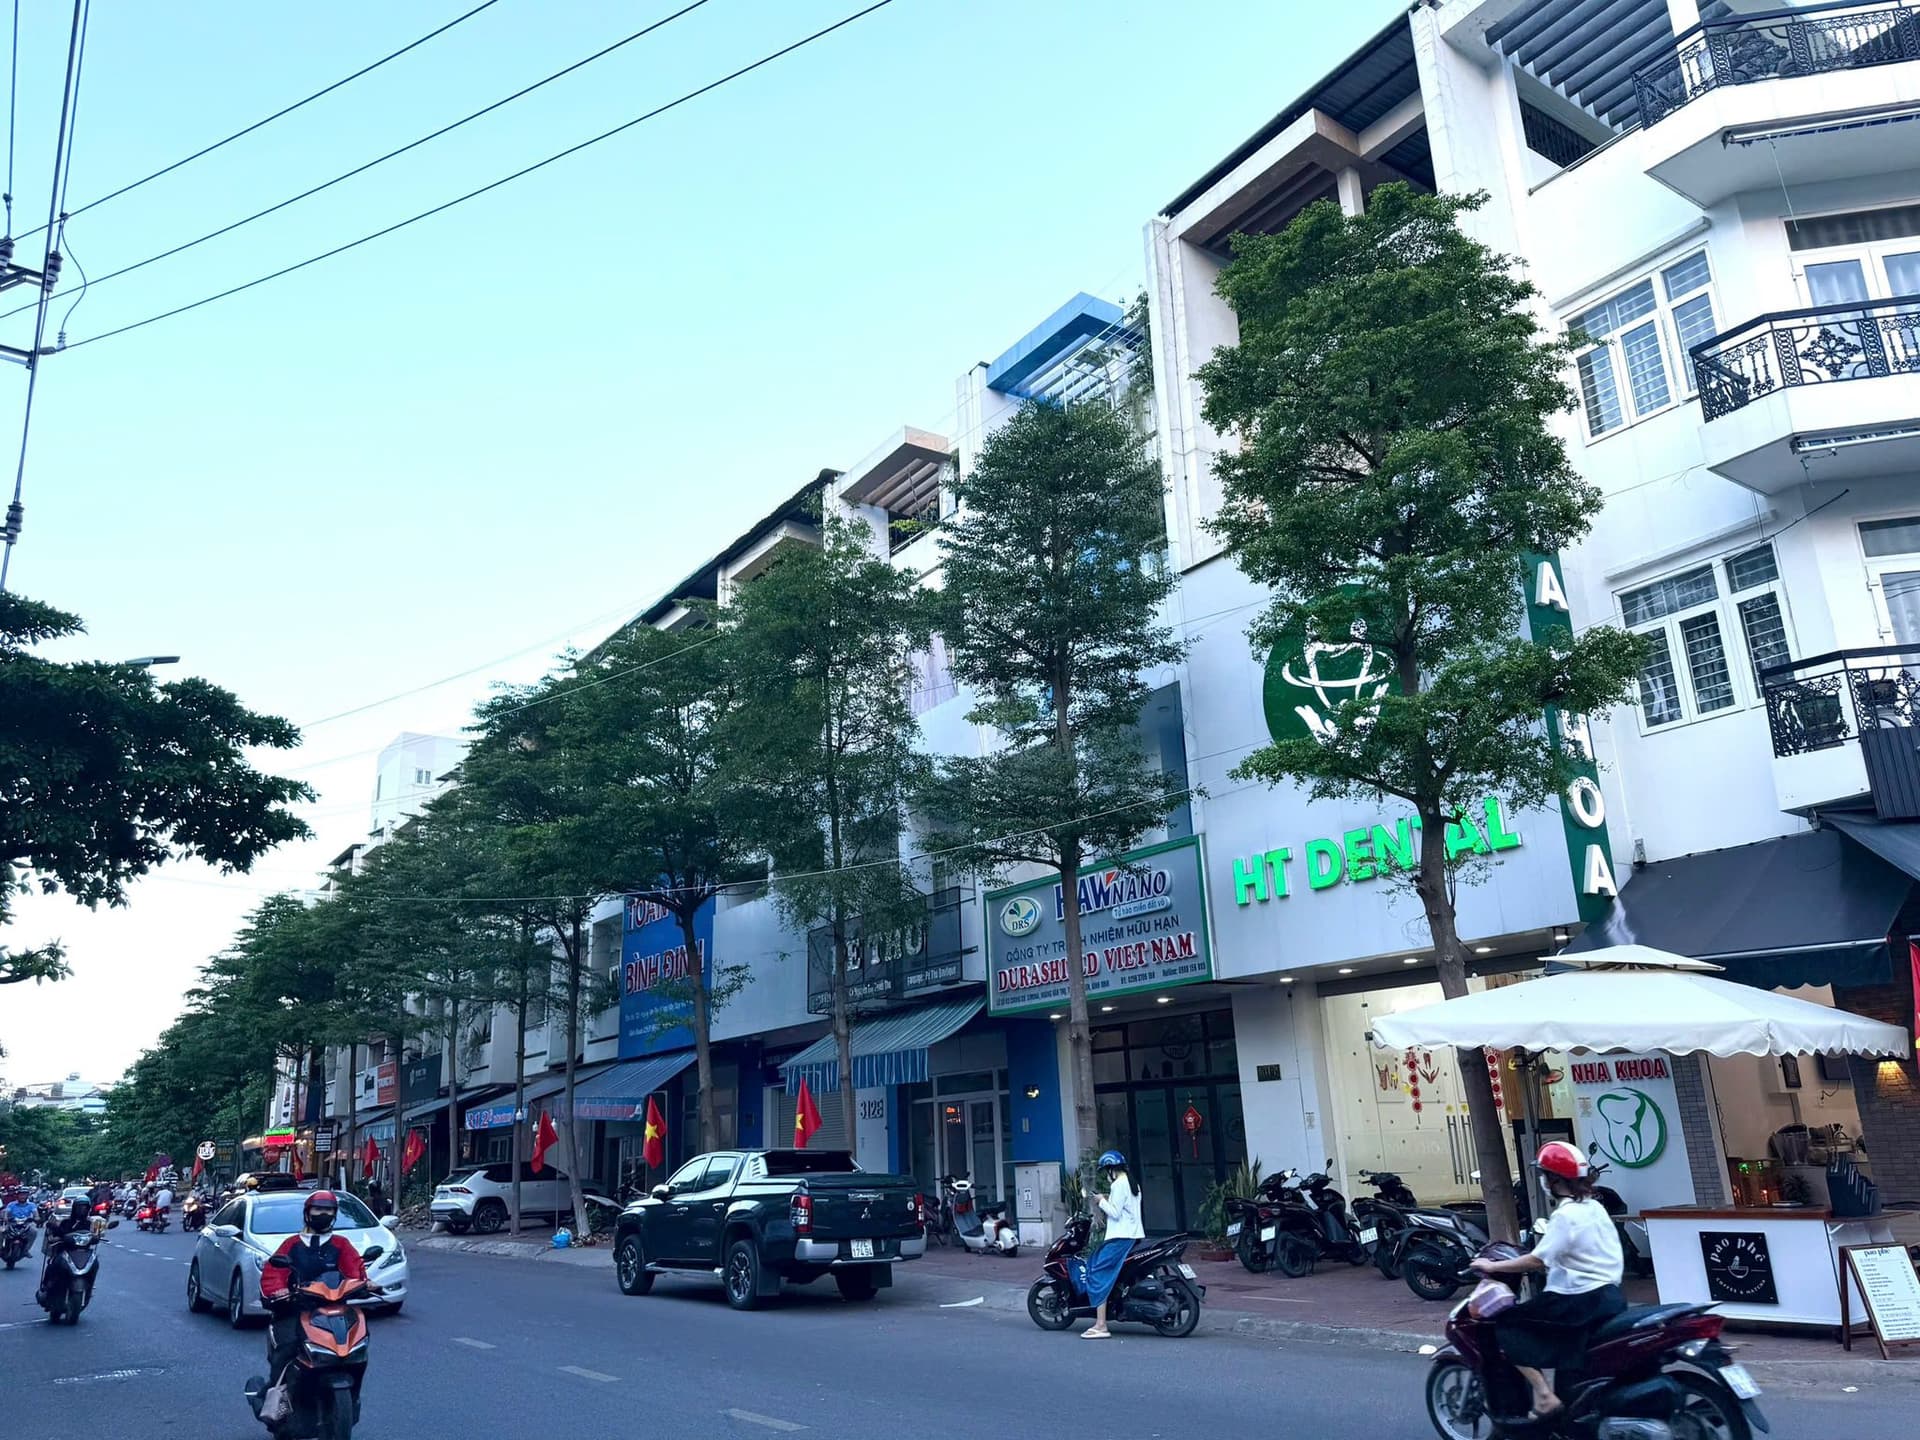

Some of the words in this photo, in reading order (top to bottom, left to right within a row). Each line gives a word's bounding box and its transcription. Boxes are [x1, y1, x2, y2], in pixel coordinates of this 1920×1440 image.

[1232, 848, 1292, 906] HT
[1305, 795, 1522, 890] DENAL
[1007, 946, 1034, 962] CÔNG
[1036, 943, 1048, 956] TY
[1090, 926, 1124, 945] NHIỆM
[1127, 919, 1151, 937] HỮU
[1154, 915, 1179, 932] HẠN
[1012, 918, 1030, 931] DRS
[1151, 931, 1197, 963] NAM
[625, 951, 660, 995] BÌNH
[1571, 1062, 1610, 1083] NHA
[1615, 1058, 1668, 1080] KHOA
[1710, 1238, 1729, 1263] pao
